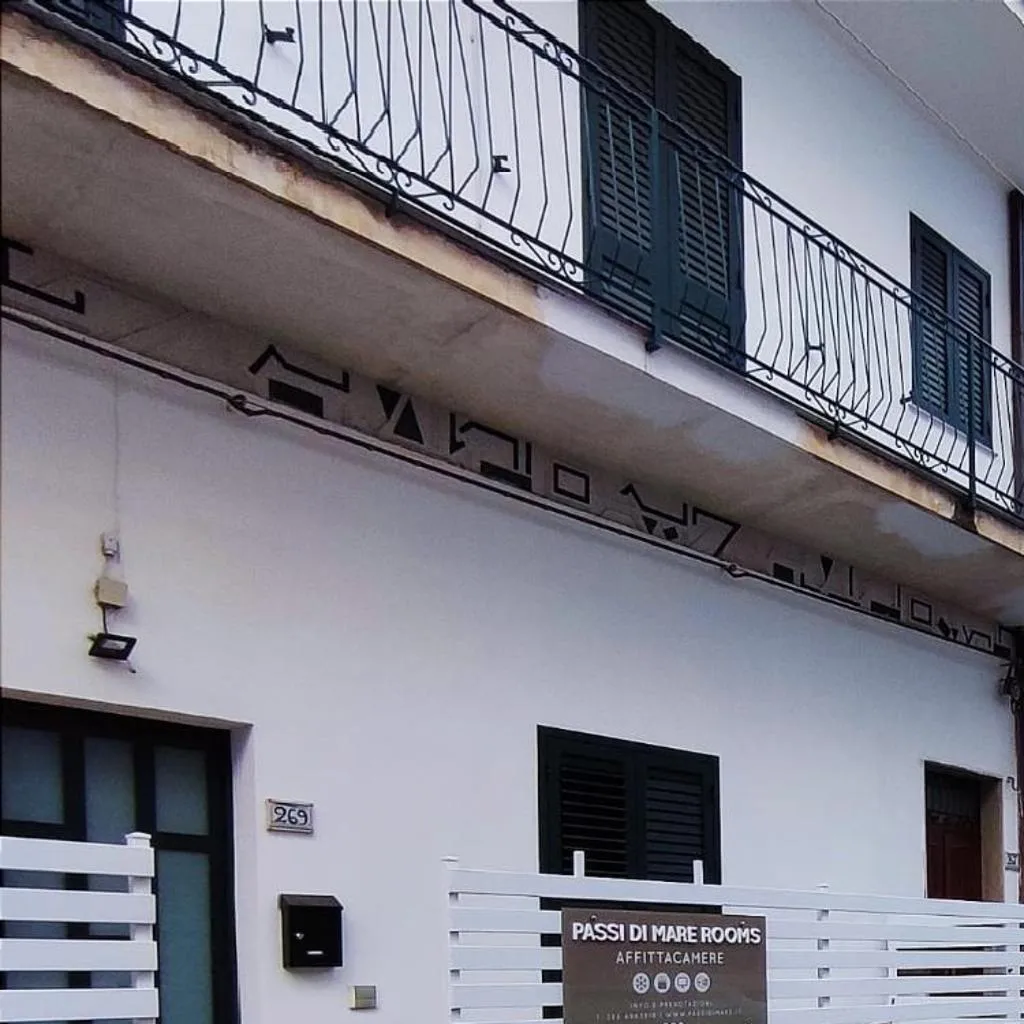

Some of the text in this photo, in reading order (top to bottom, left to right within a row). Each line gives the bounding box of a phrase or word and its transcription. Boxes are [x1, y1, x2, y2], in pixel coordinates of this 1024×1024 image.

[274, 806, 308, 826] 269
[572, 922, 762, 944] PASSI DI MARE ROOMS
[615, 951, 724, 965] AFFITTACAMERE
